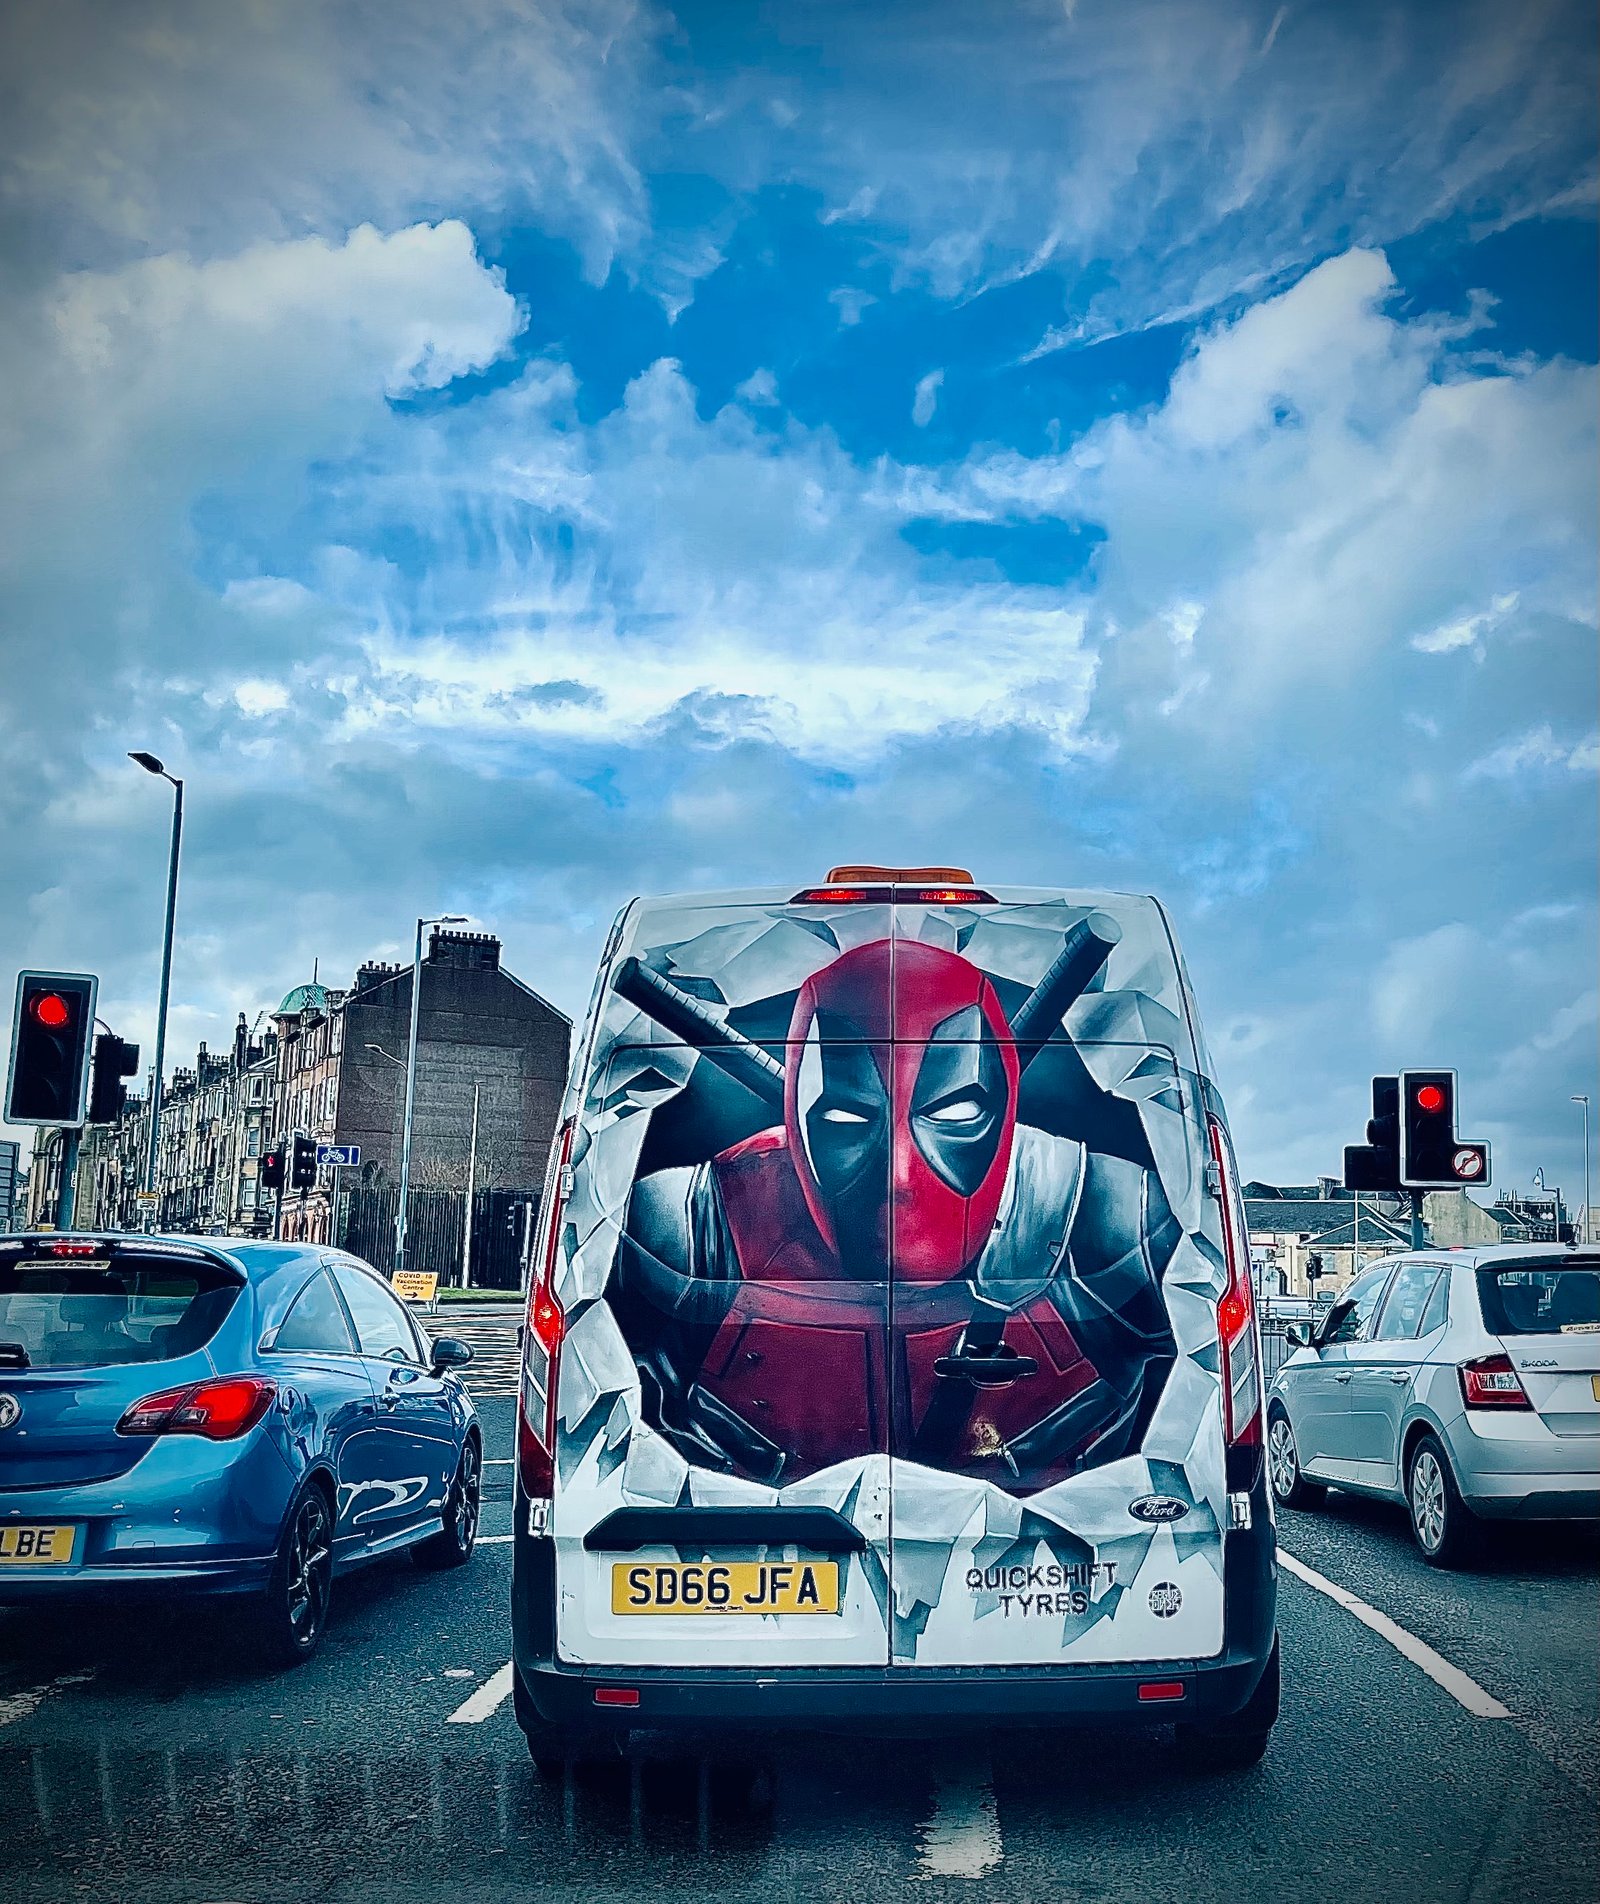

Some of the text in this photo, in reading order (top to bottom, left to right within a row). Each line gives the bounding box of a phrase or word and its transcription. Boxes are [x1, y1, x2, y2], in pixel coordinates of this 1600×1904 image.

[1143, 1500, 1178, 1515] Ford
[0, 1530, 56, 1556] LBE
[629, 1567, 819, 1604] SD66 JFA
[966, 1562, 1118, 1591] QUICKSHIFT
[999, 1591, 1089, 1619] TYRES
